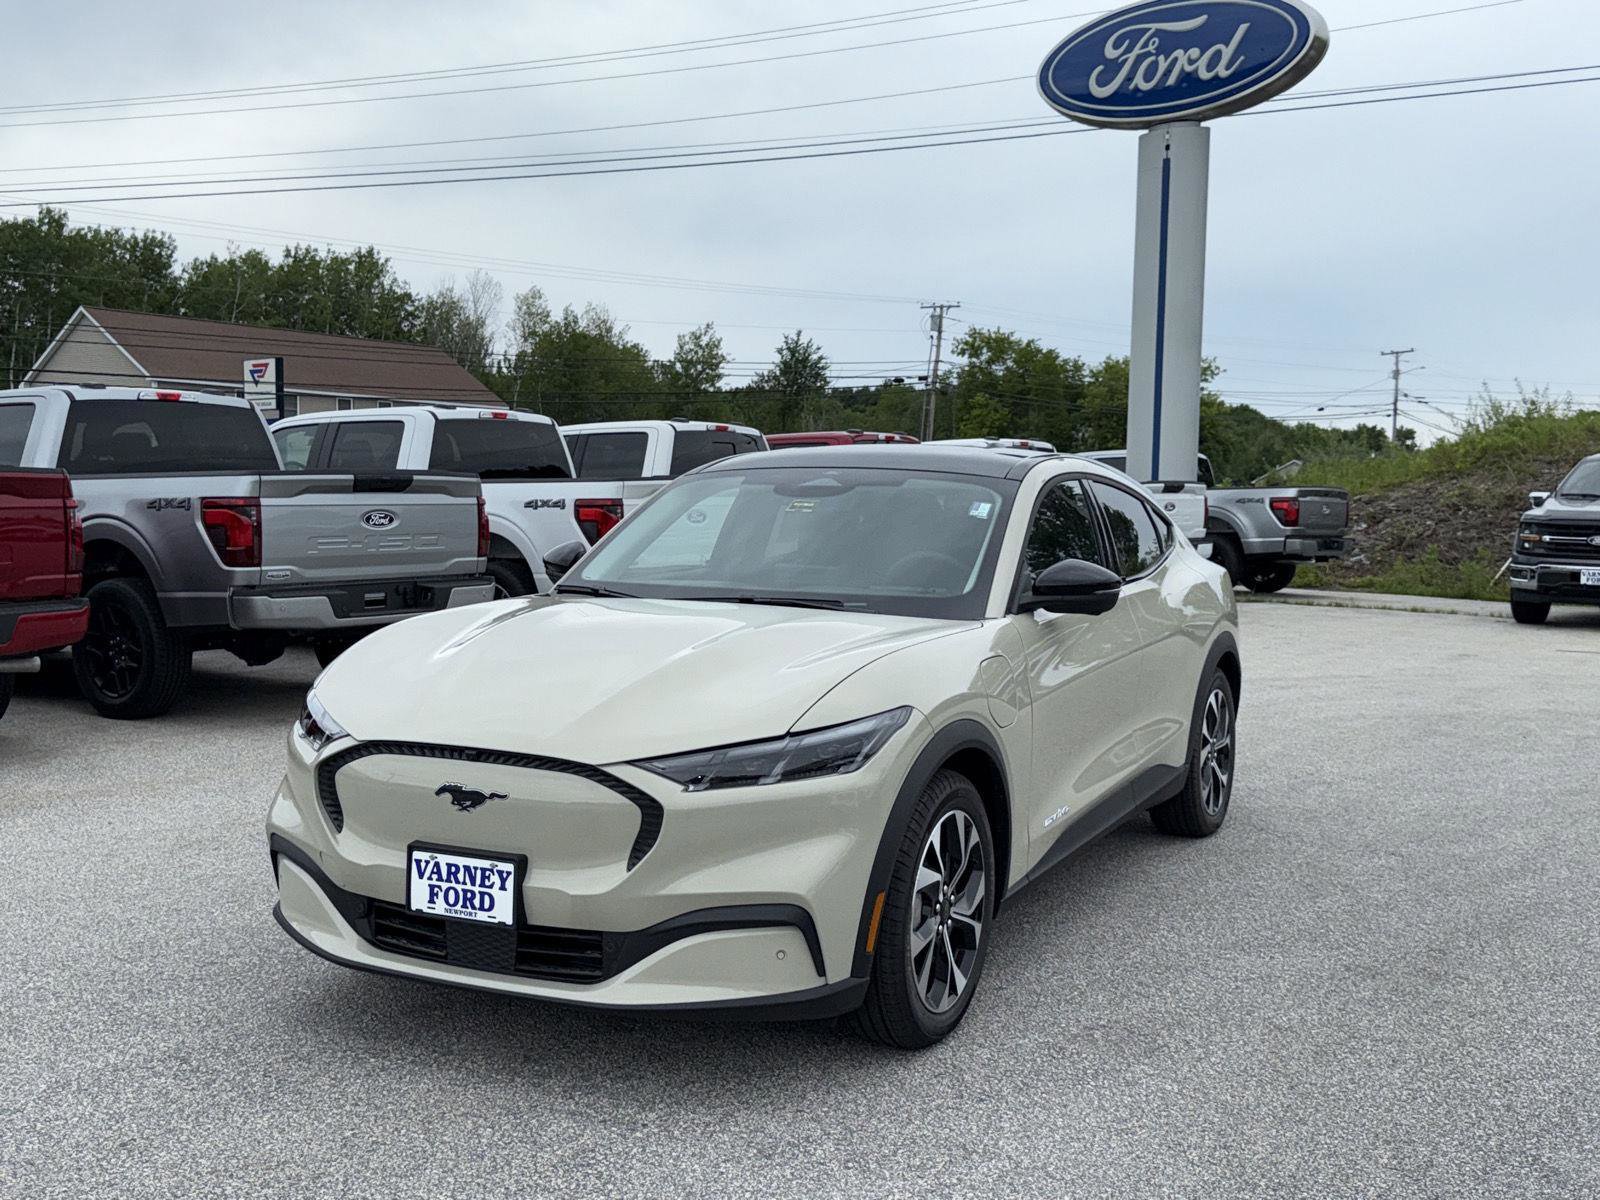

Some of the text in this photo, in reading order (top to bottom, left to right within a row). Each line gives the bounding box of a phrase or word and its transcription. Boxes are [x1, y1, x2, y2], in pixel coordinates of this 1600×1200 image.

[1088, 14, 1251, 98] Ford
[369, 513, 391, 526] Ford
[414, 858, 512, 891] VARNEY
[427, 883, 495, 912] FORD
[443, 907, 478, 918] NEWPORT
